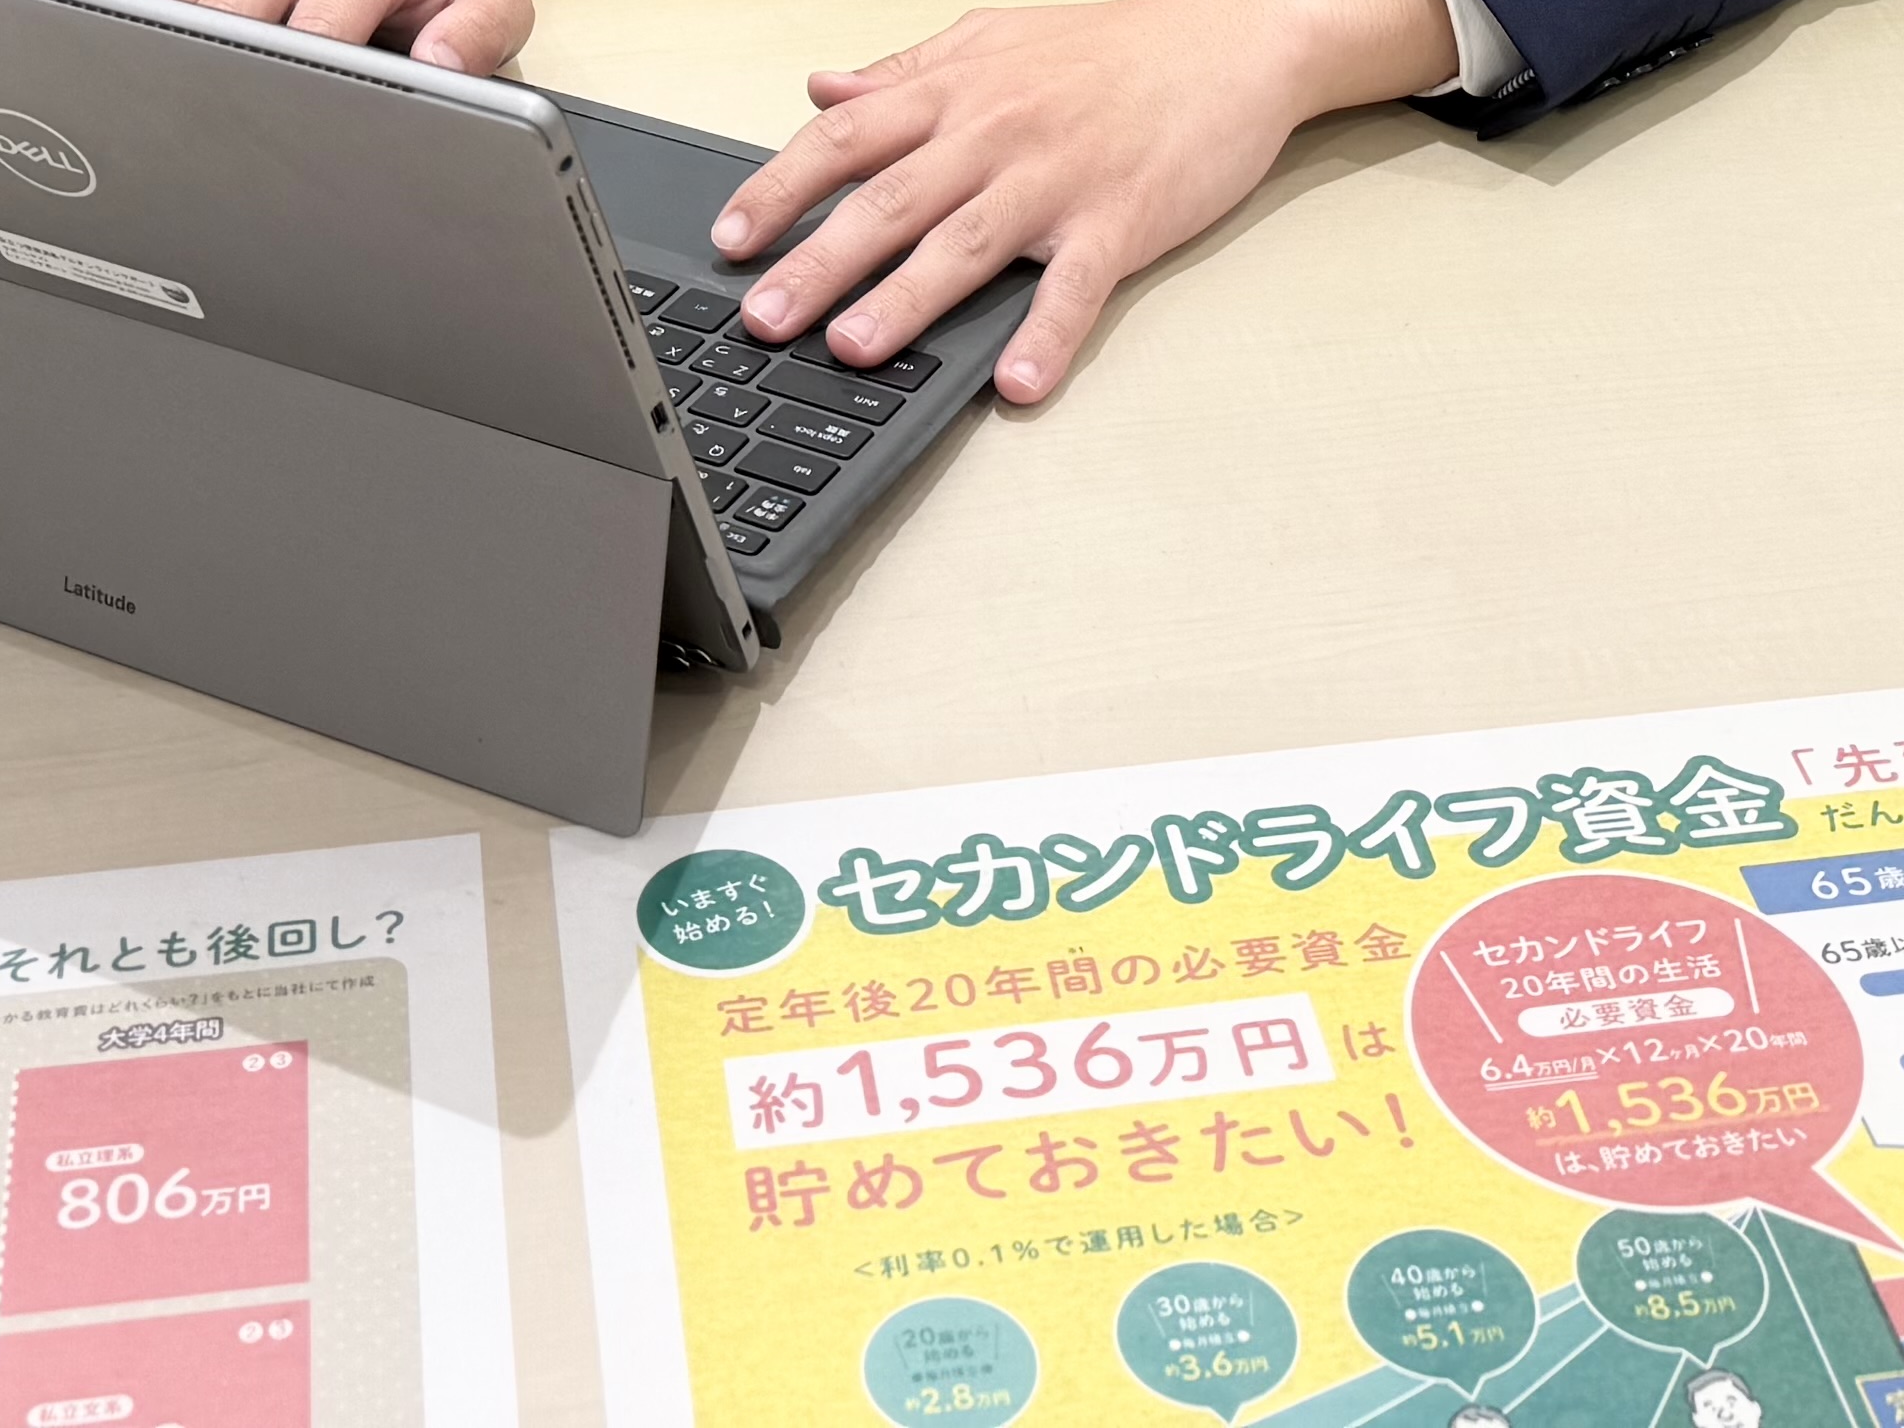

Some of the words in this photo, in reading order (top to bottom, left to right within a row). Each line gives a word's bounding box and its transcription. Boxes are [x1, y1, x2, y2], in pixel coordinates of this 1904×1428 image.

[665, 345, 682, 357] X
[893, 359, 915, 373] ctrl
[733, 364, 750, 376] Z
[732, 406, 748, 419] A
[853, 392, 880, 408] shift
[708, 443, 726, 458] Q
[818, 429, 844, 444] caps
[793, 463, 812, 476] tab
[725, 531, 747, 544] Esc
[62, 574, 137, 616] Latitude
[824, 760, 1790, 934] セカンドライフ資金
[661, 873, 772, 920] いますぐ
[672, 898, 778, 946] 始める！
[1472, 917, 1708, 968] セカンドライフ
[715, 921, 1413, 1039] 定年後20年間の必要資金
[1499, 953, 1723, 1001] 20年間の生活
[1558, 993, 1698, 1032] 必要資金
[100, 1019, 222, 1050] 大学4年間
[1524, 1070, 1821, 1136] 約1,536万円
[745, 1091, 1416, 1234] 貯めておきたい！
[1554, 1127, 1809, 1177] は、貯めておきたい
[56, 1166, 272, 1231] 806万円
[1616, 1234, 1703, 1260] 50歳から
[1390, 1263, 1477, 1287] 40歳から
[1156, 1292, 1244, 1318] 30歳から
[901, 1325, 990, 1349] 20歳から
[1163, 1348, 1271, 1383] 約3.6万円
[904, 1383, 1012, 1416] 約2.8万円
